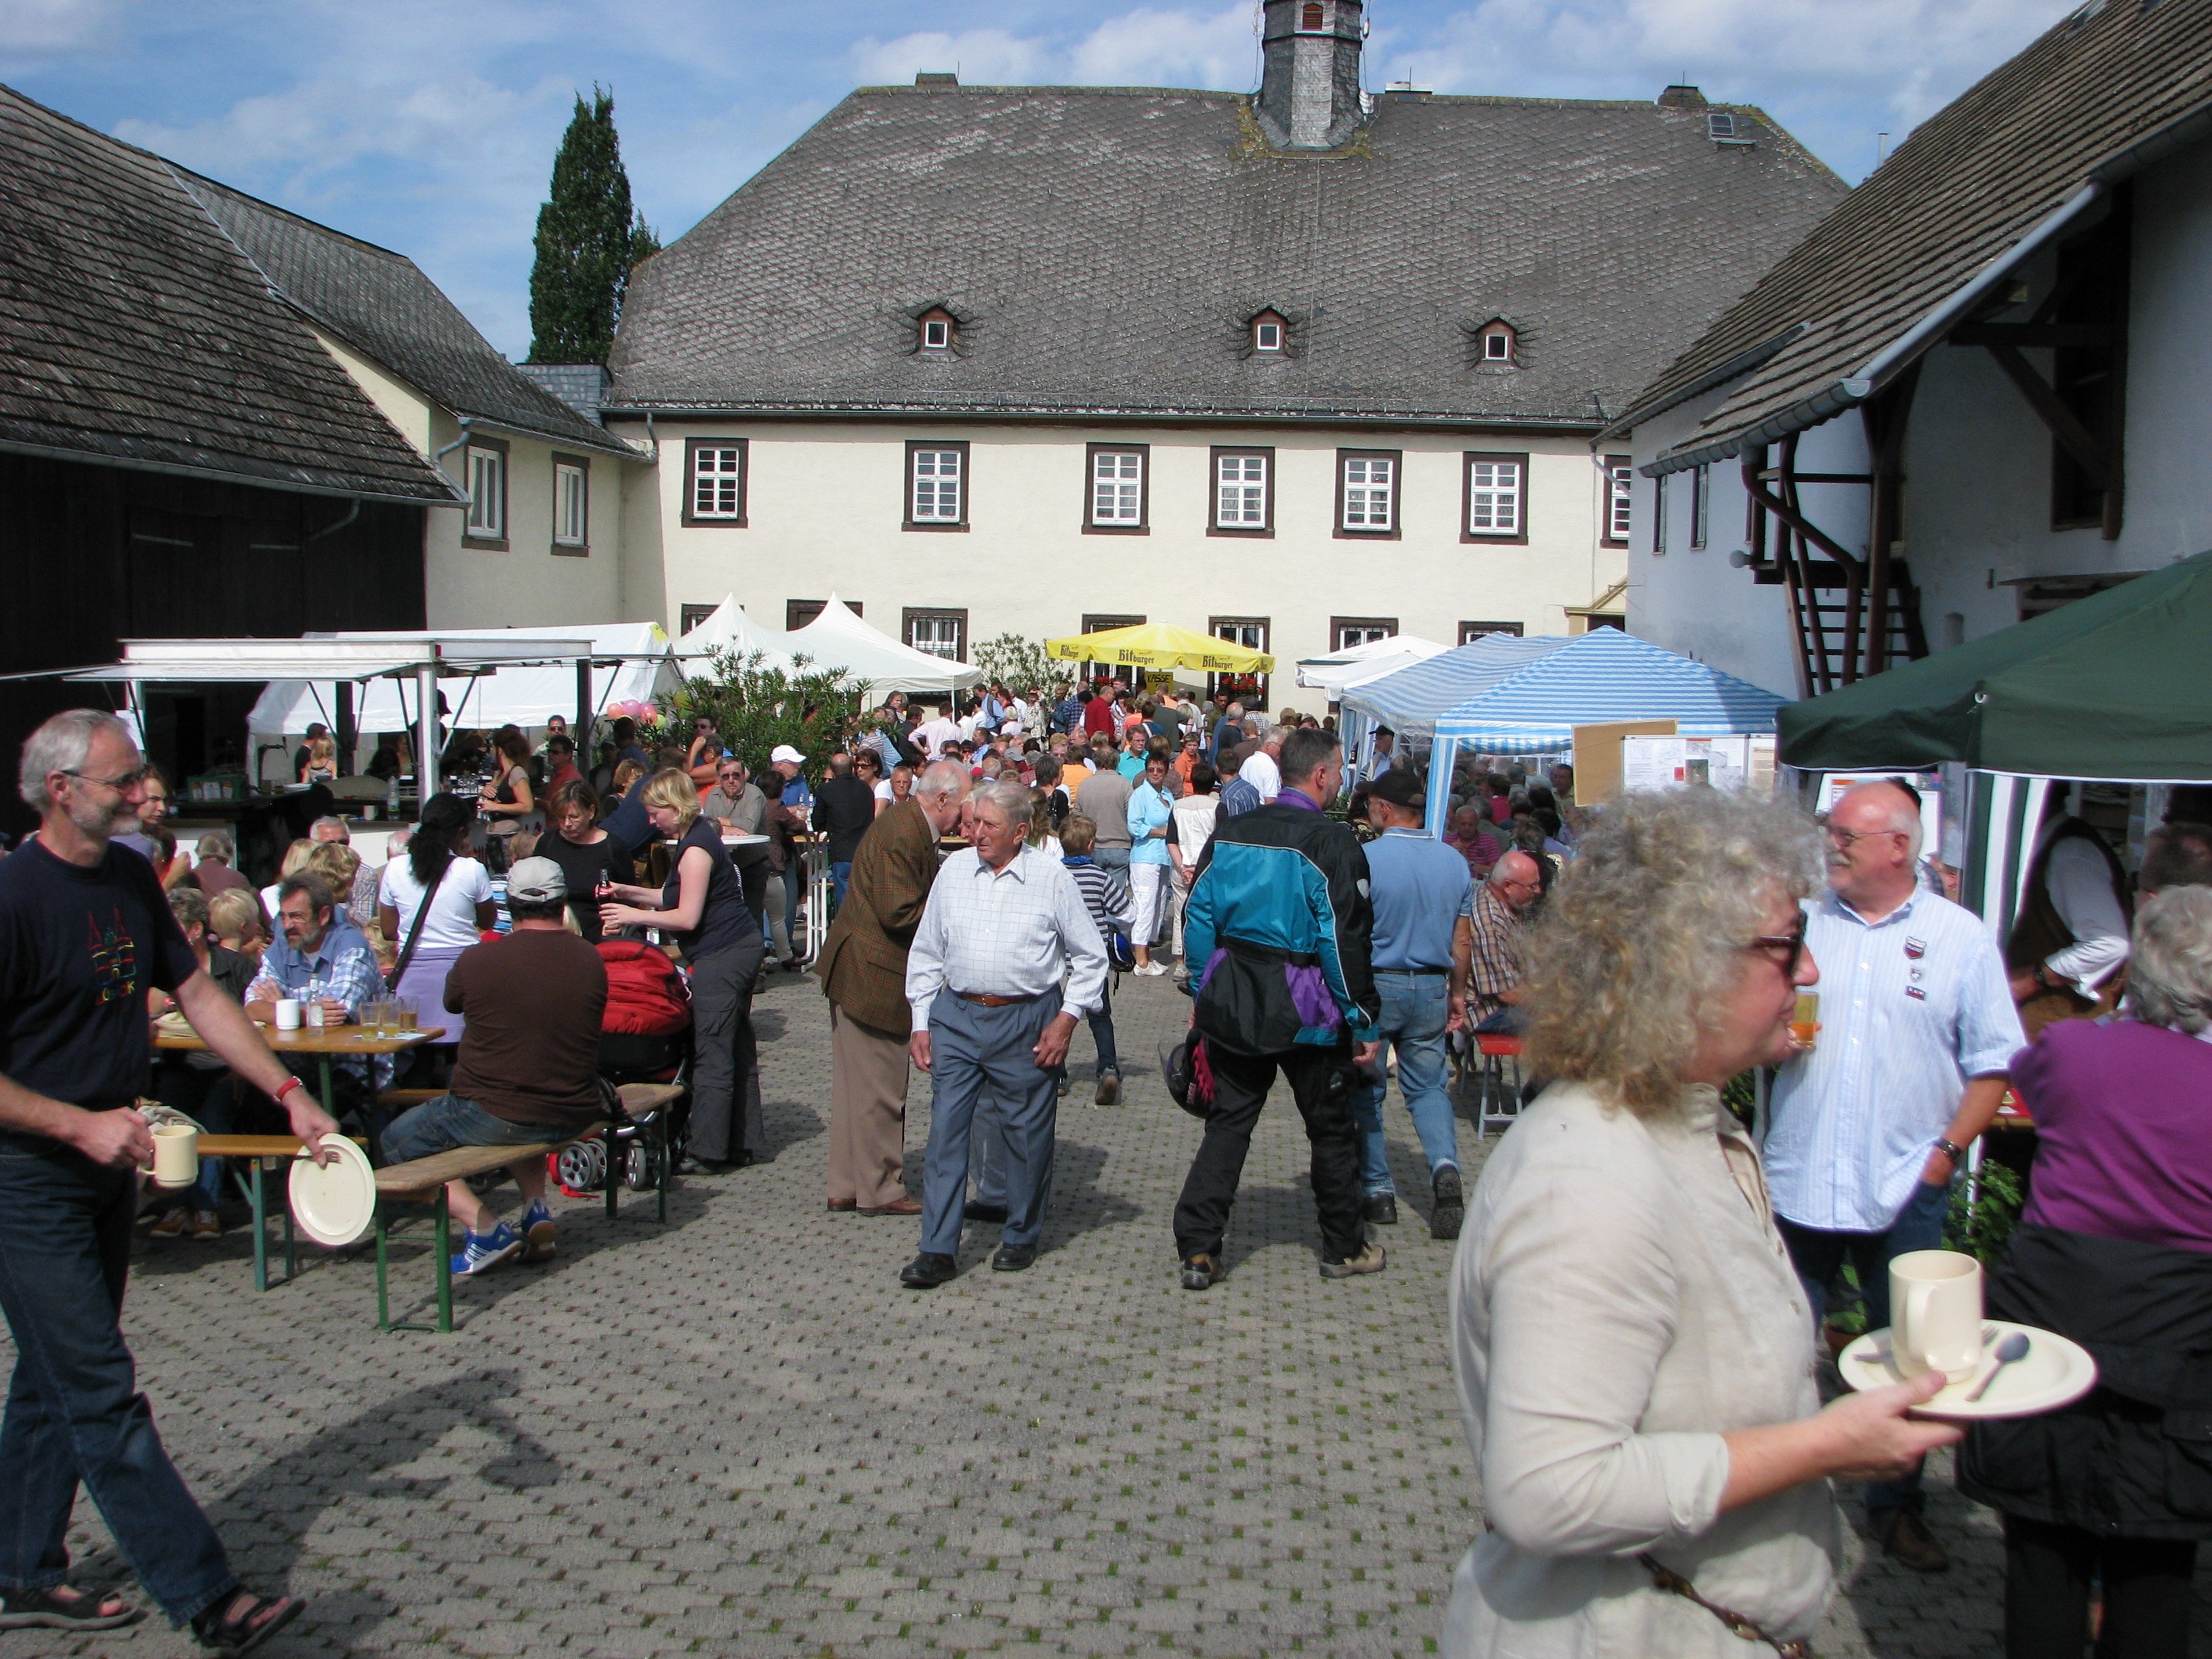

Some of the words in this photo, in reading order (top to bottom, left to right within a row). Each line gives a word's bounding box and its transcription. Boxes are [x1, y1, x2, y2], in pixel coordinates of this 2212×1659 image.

[1118, 649, 1155, 665] Bitburger
[1202, 655, 1233, 670] Bitburger
[1147, 674, 1171, 683] KASSE
